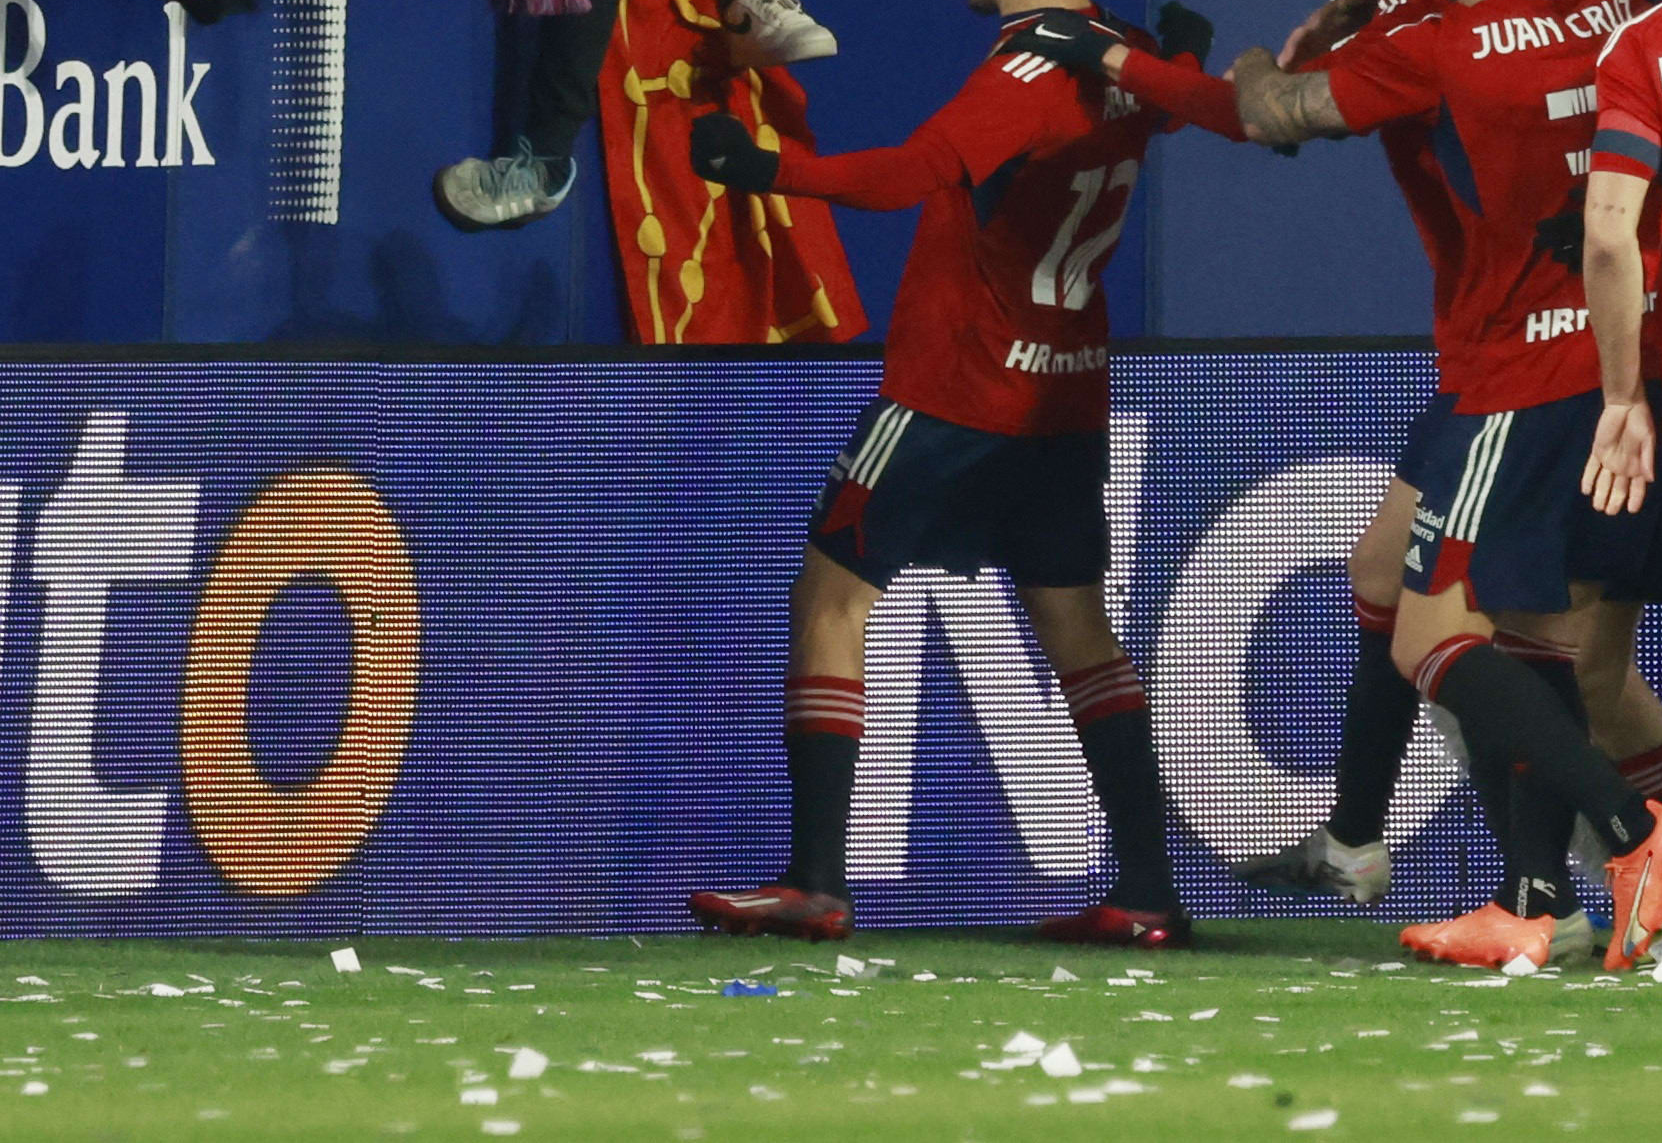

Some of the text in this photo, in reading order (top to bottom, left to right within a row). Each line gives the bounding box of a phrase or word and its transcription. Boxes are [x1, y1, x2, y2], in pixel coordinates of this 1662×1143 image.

[1472, 15, 1565, 60] JUAN
[1031, 158, 1140, 311] 12
[0, 411, 422, 896] to
